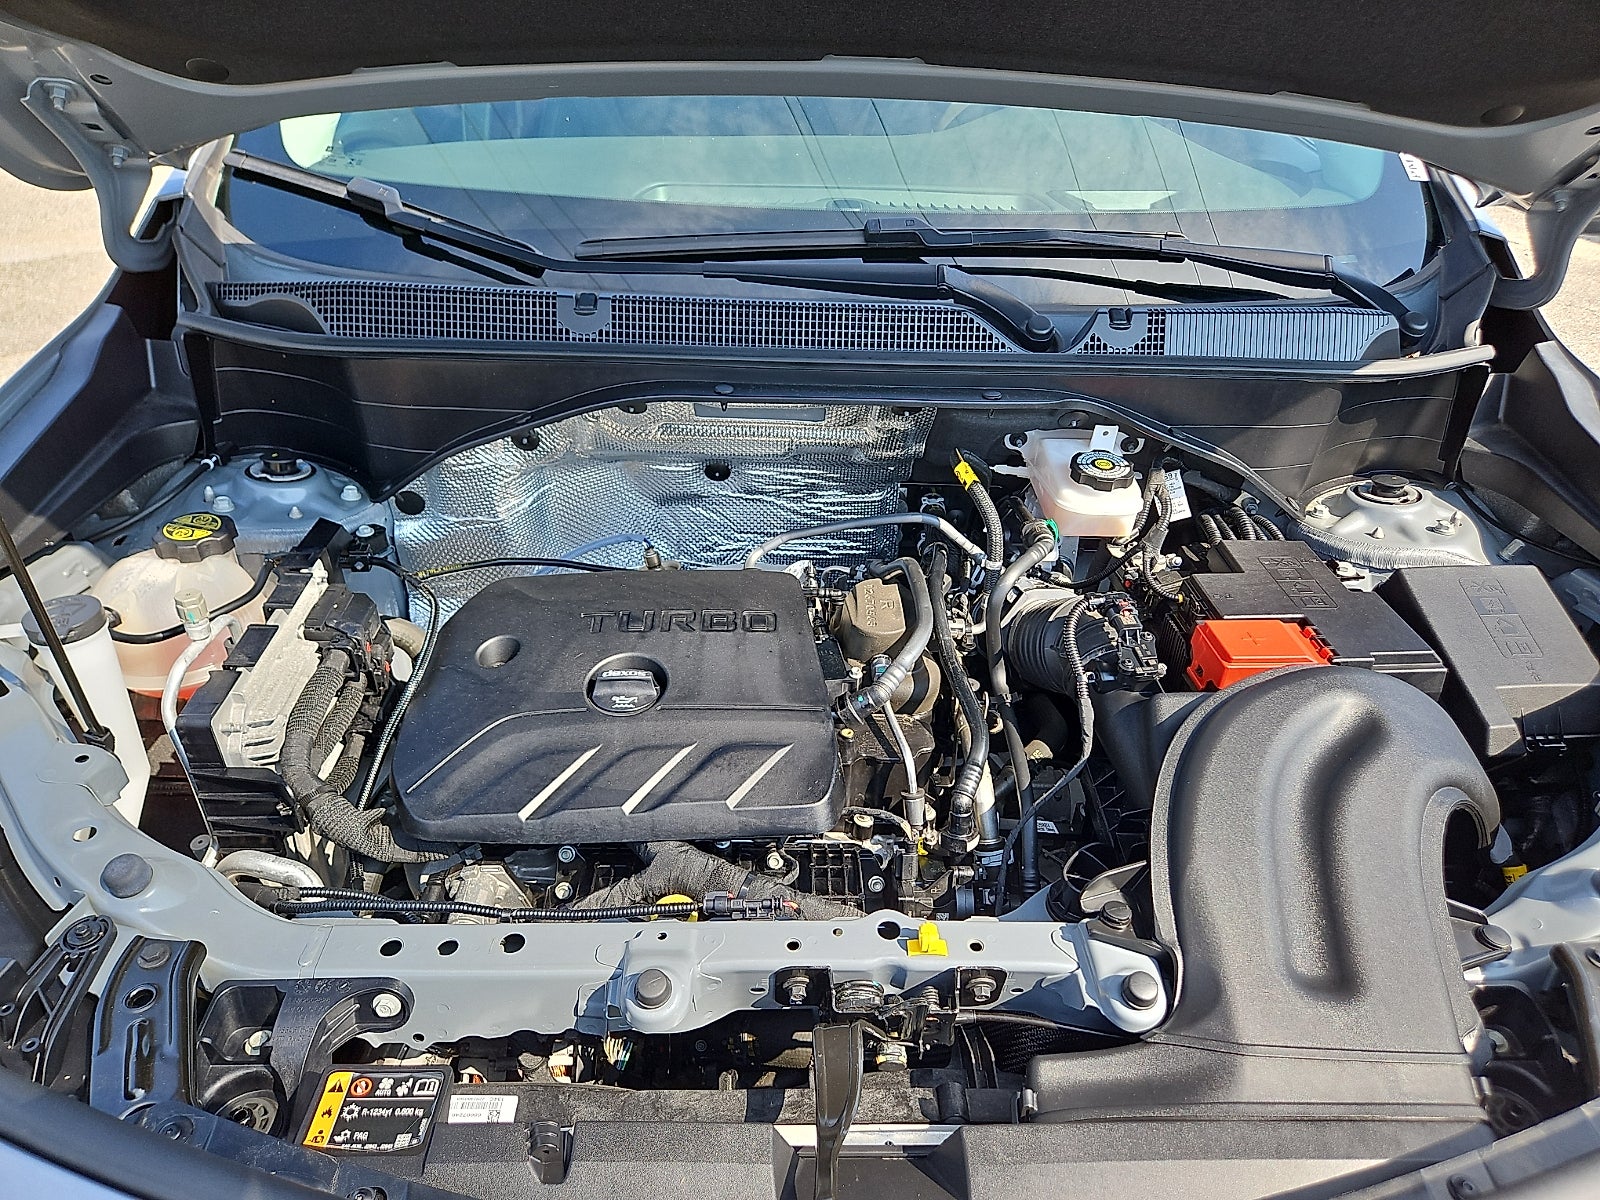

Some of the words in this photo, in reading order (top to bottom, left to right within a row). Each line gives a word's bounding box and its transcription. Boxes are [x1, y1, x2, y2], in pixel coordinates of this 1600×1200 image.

[580, 608, 777, 633] TURBO
[375, 1089, 392, 1097] AUTO
[414, 1107, 425, 1118] kg
[353, 1131, 369, 1142] PAG
